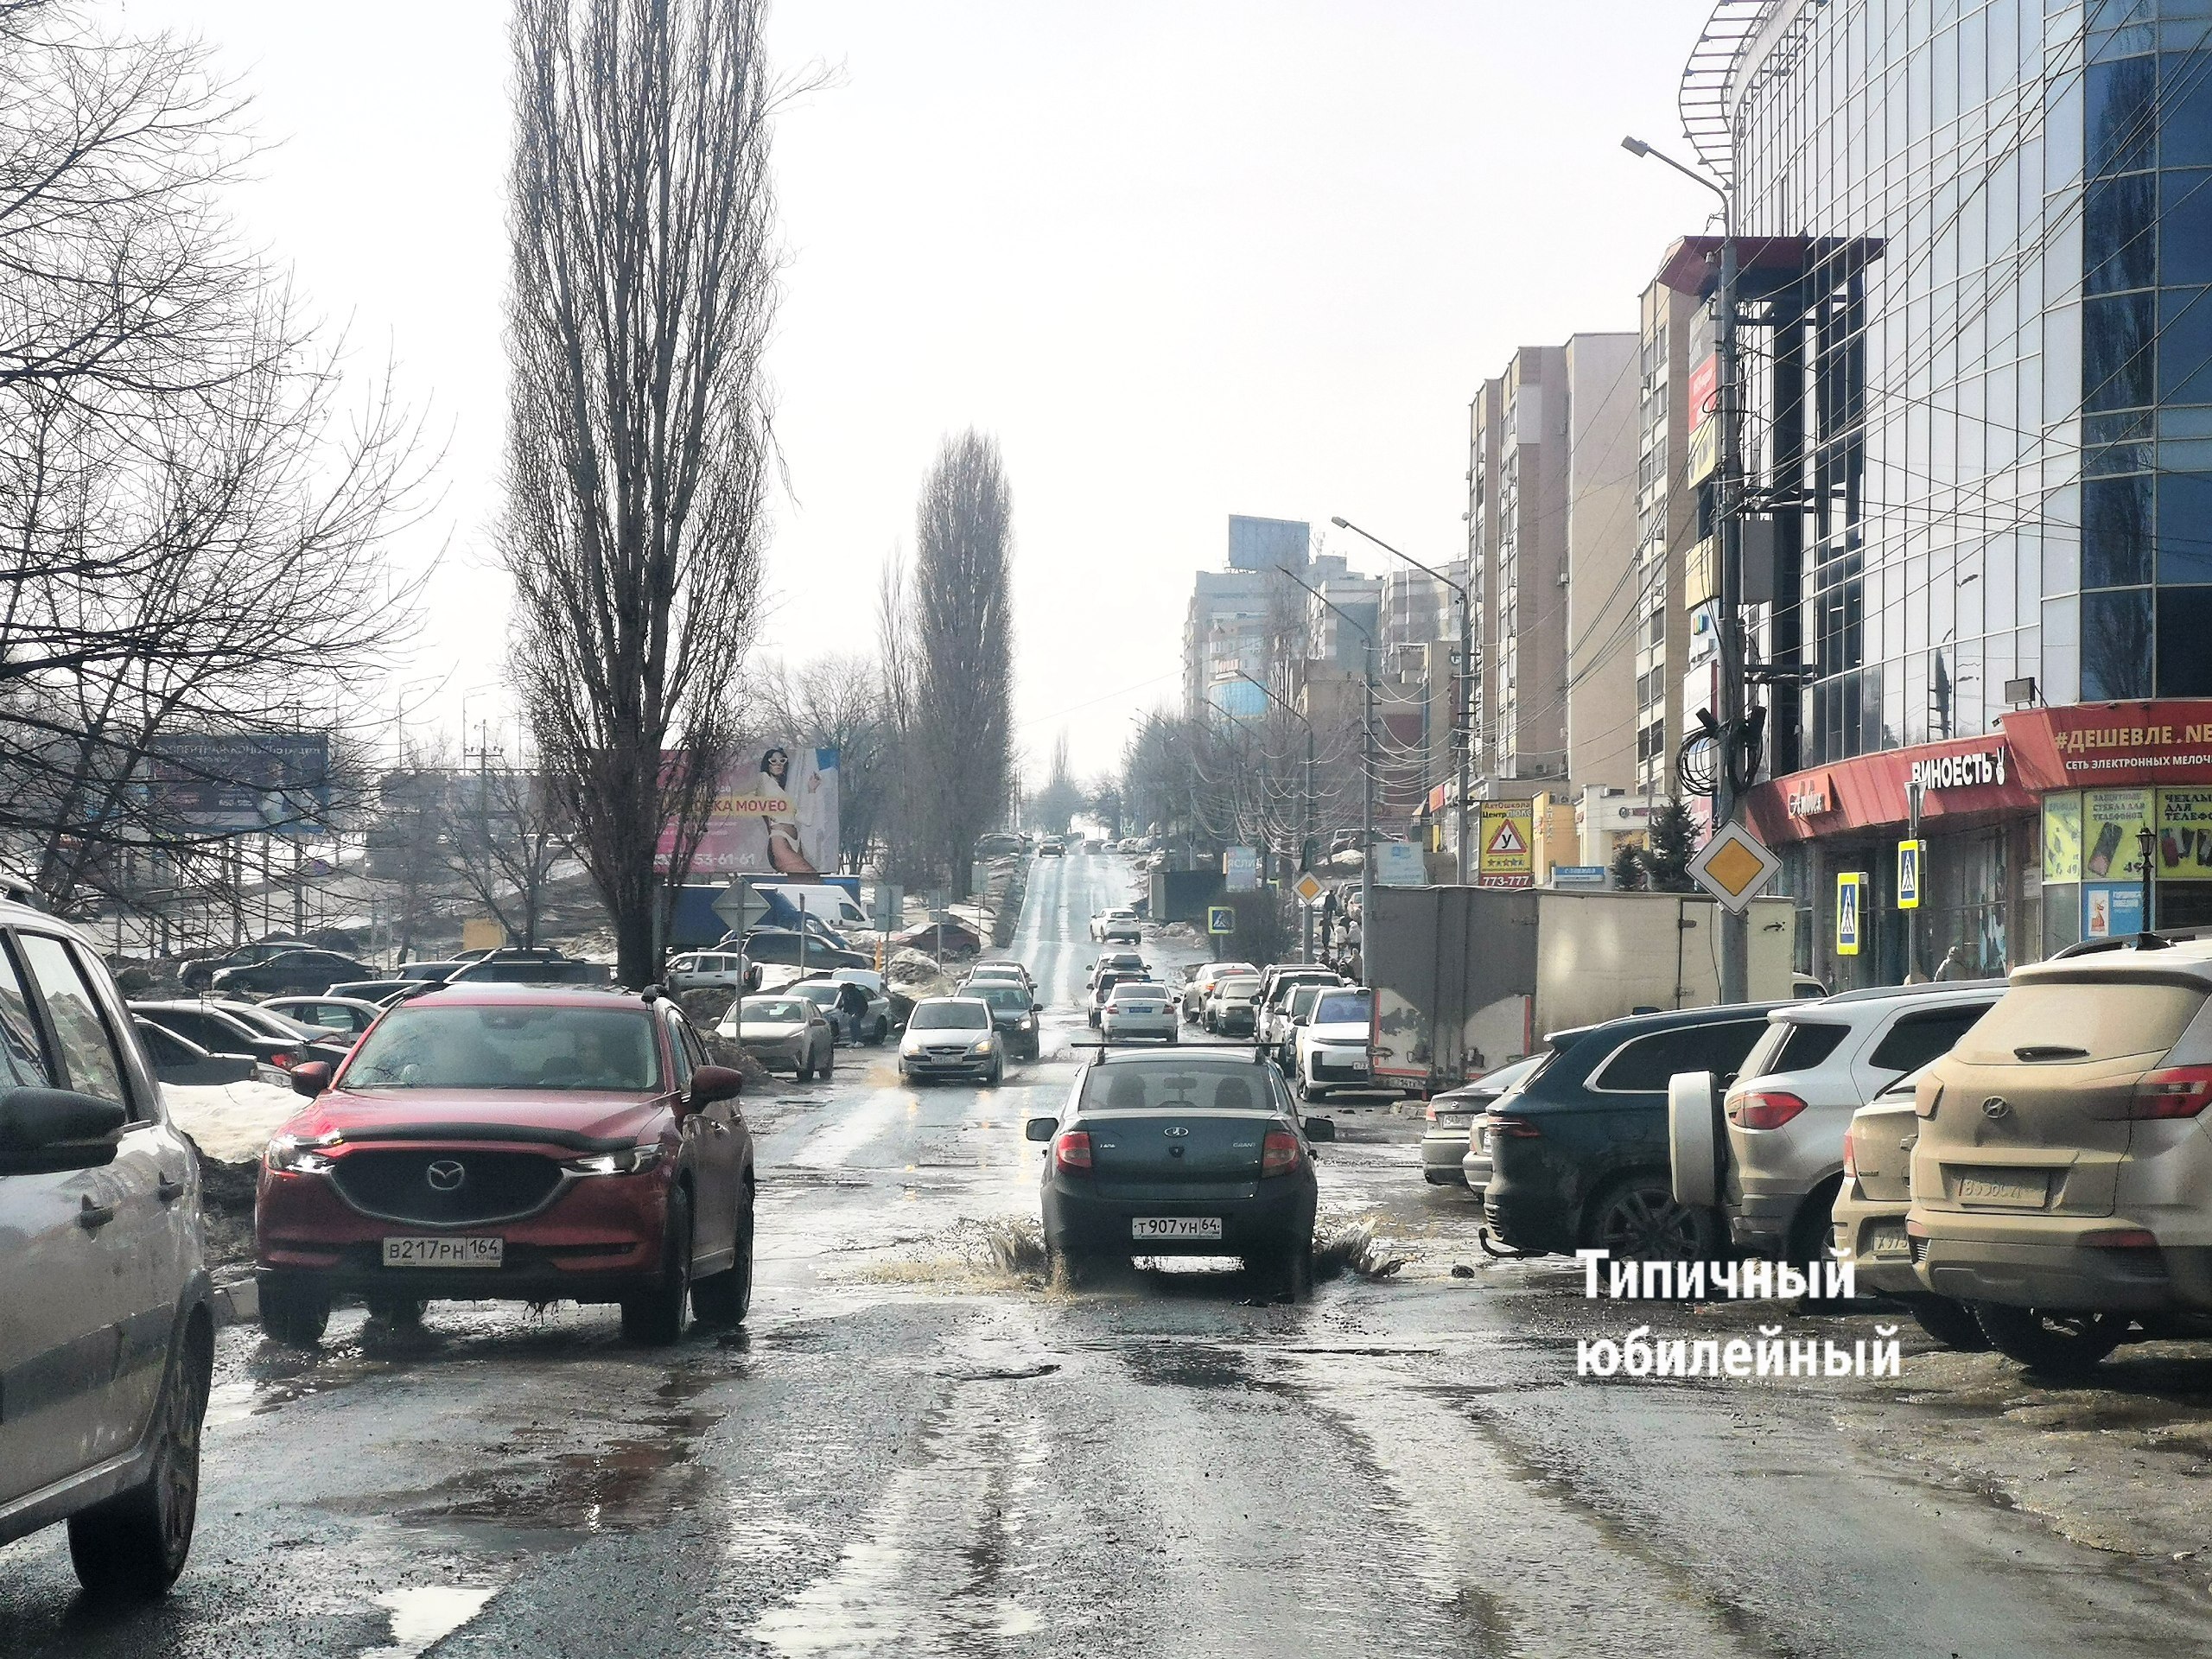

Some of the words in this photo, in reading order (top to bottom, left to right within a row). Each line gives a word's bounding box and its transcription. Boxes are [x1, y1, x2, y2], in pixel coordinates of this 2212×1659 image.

[2065, 760, 2089, 770] СЕТЬ
[2091, 756, 2170, 769] ЭЛЕКТРОННЫХ
[2172, 754, 2212, 766] МЕЛОЧ
[736, 799, 787, 812] MOVEO
[1483, 875, 1529, 886] 773-777
